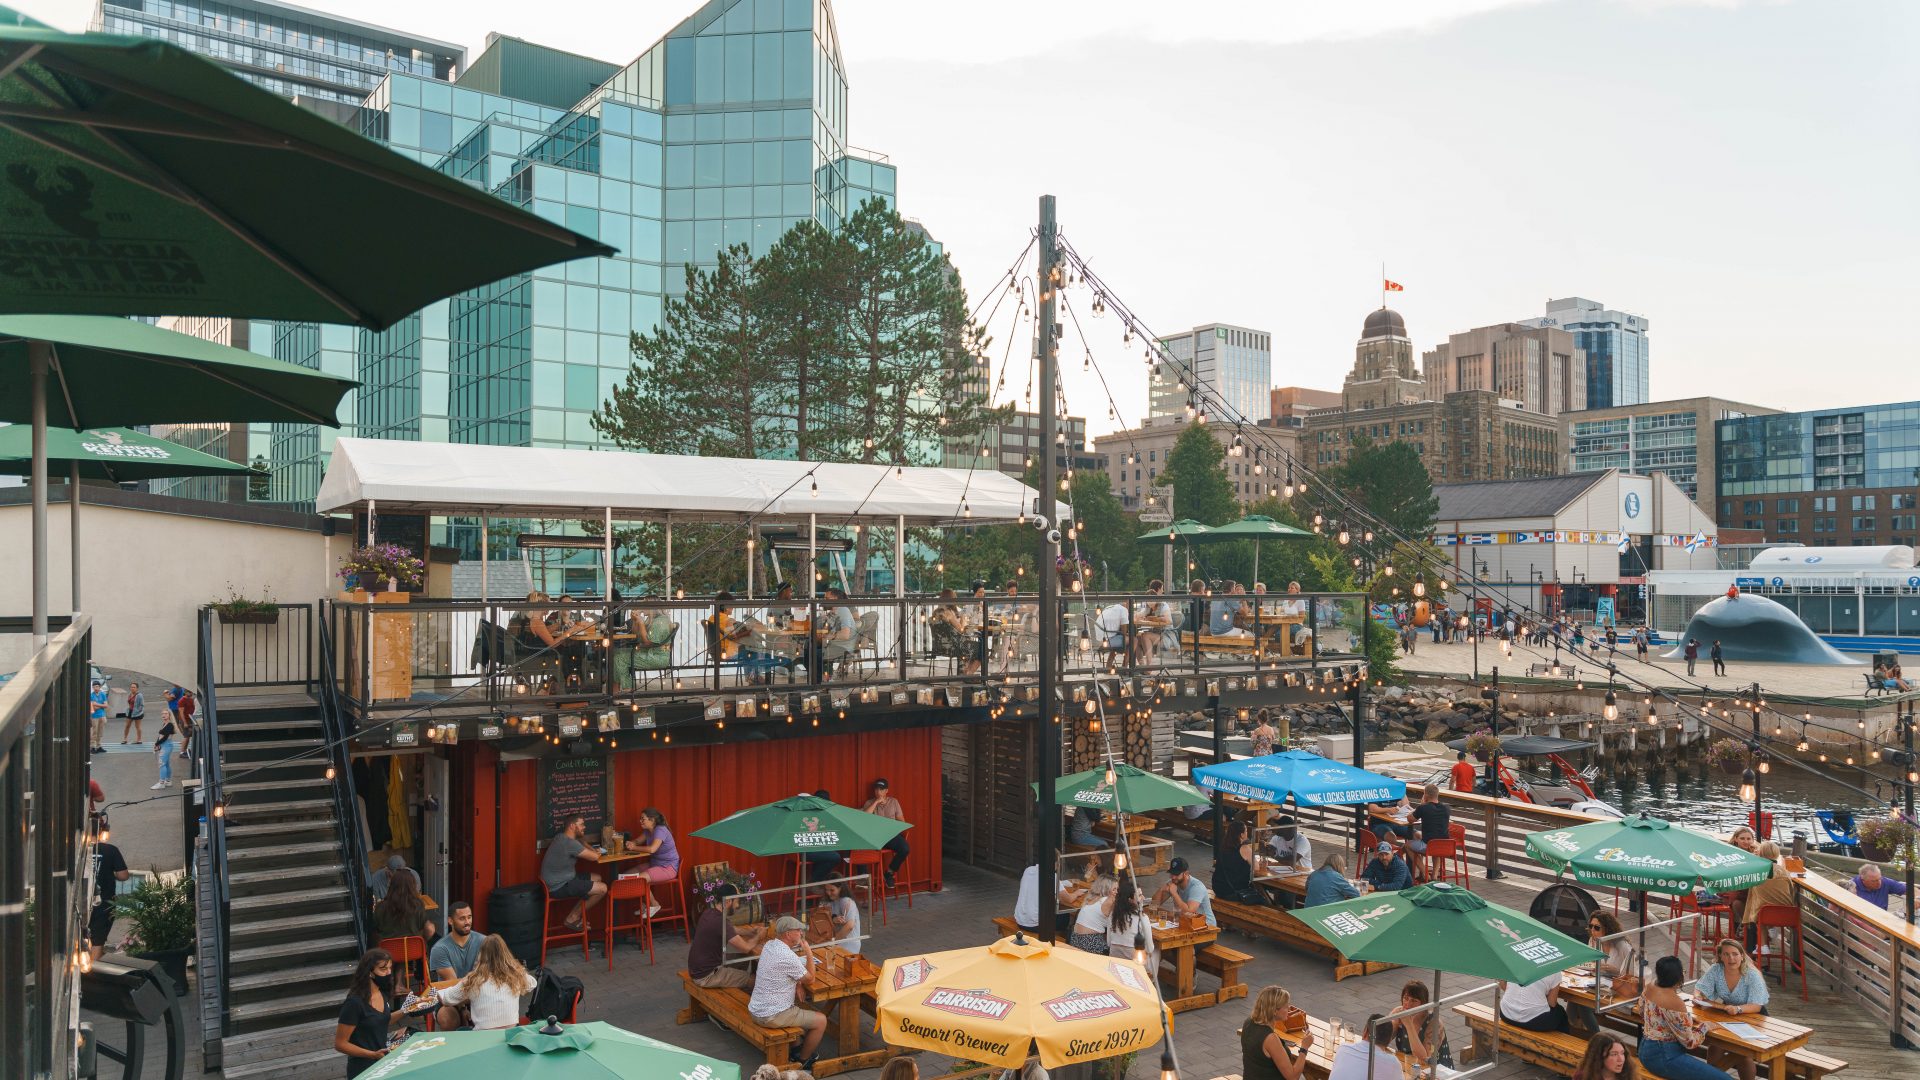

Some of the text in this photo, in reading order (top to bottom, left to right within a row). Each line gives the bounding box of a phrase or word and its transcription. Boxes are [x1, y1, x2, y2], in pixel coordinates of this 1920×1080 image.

[1201, 775, 1218, 786] NINE
[1218, 778, 1238, 793] LOCKS
[1237, 783, 1266, 799] BREWING
[1306, 787, 1393, 803] NINE LOCKS BREWING CO.
[793, 835, 840, 844] KEITH'S
[1593, 847, 1677, 867] Breton
[930, 991, 1008, 1017] GARRISON
[1048, 993, 1123, 1019] GARRISON
[900, 1017, 1009, 1057] Seaport Brewed
[1065, 1028, 1145, 1057] Since 1997!
